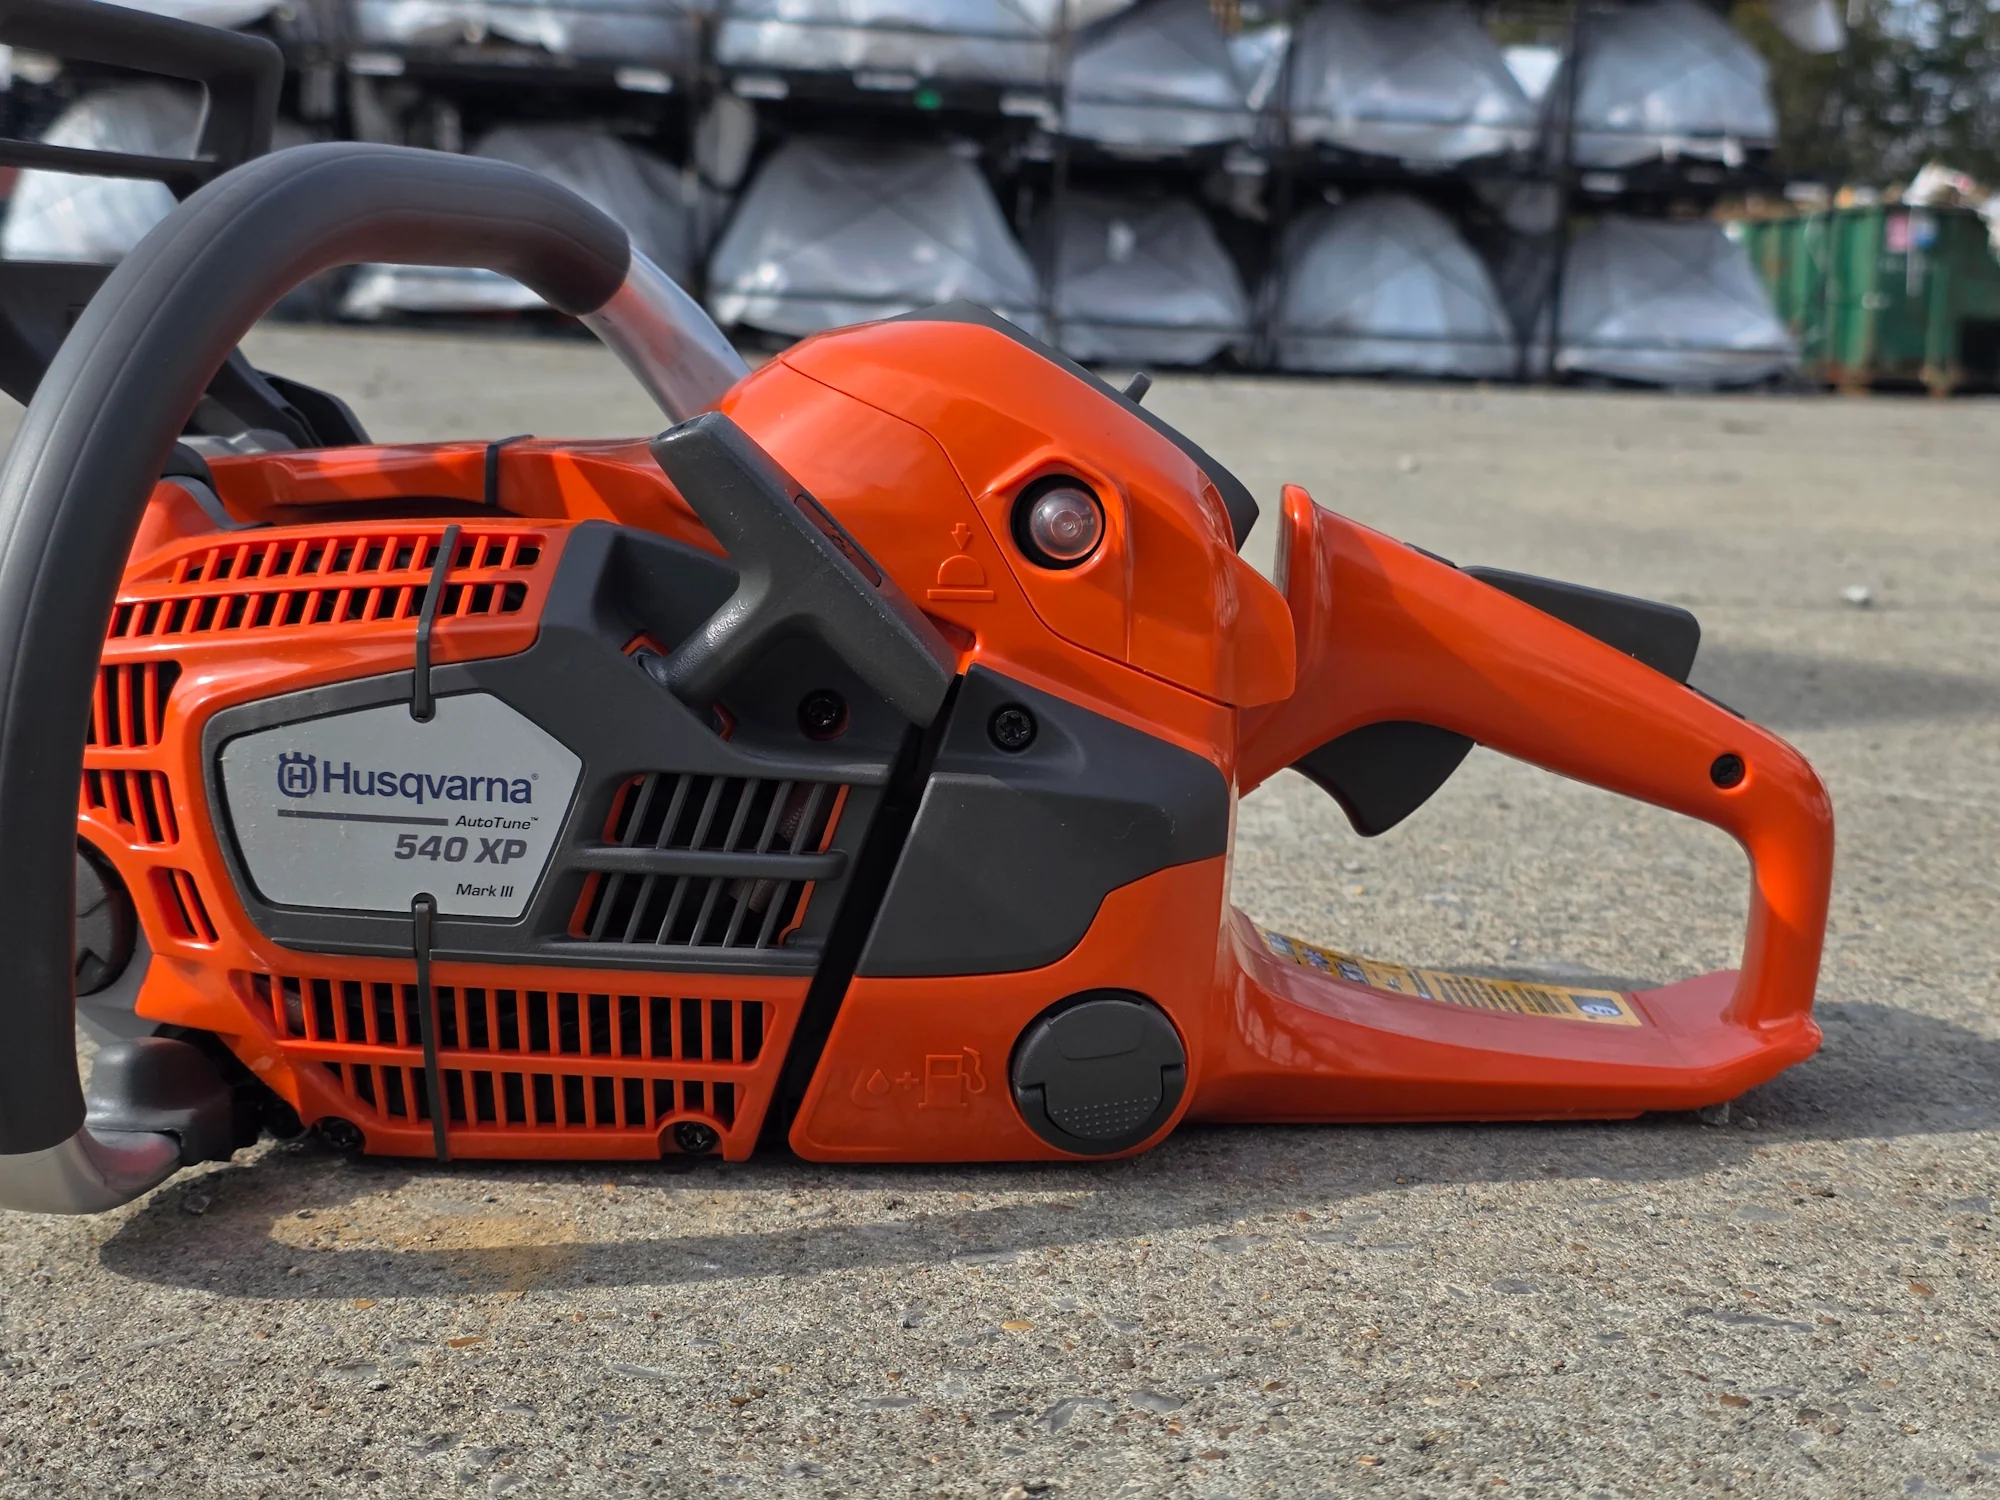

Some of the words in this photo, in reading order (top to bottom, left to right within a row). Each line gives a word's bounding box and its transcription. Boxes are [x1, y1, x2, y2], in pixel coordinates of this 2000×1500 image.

[394, 834, 468, 862] 540
[474, 837, 527, 865] XP
[456, 883, 496, 897] Mark
[500, 885, 513, 898] III
